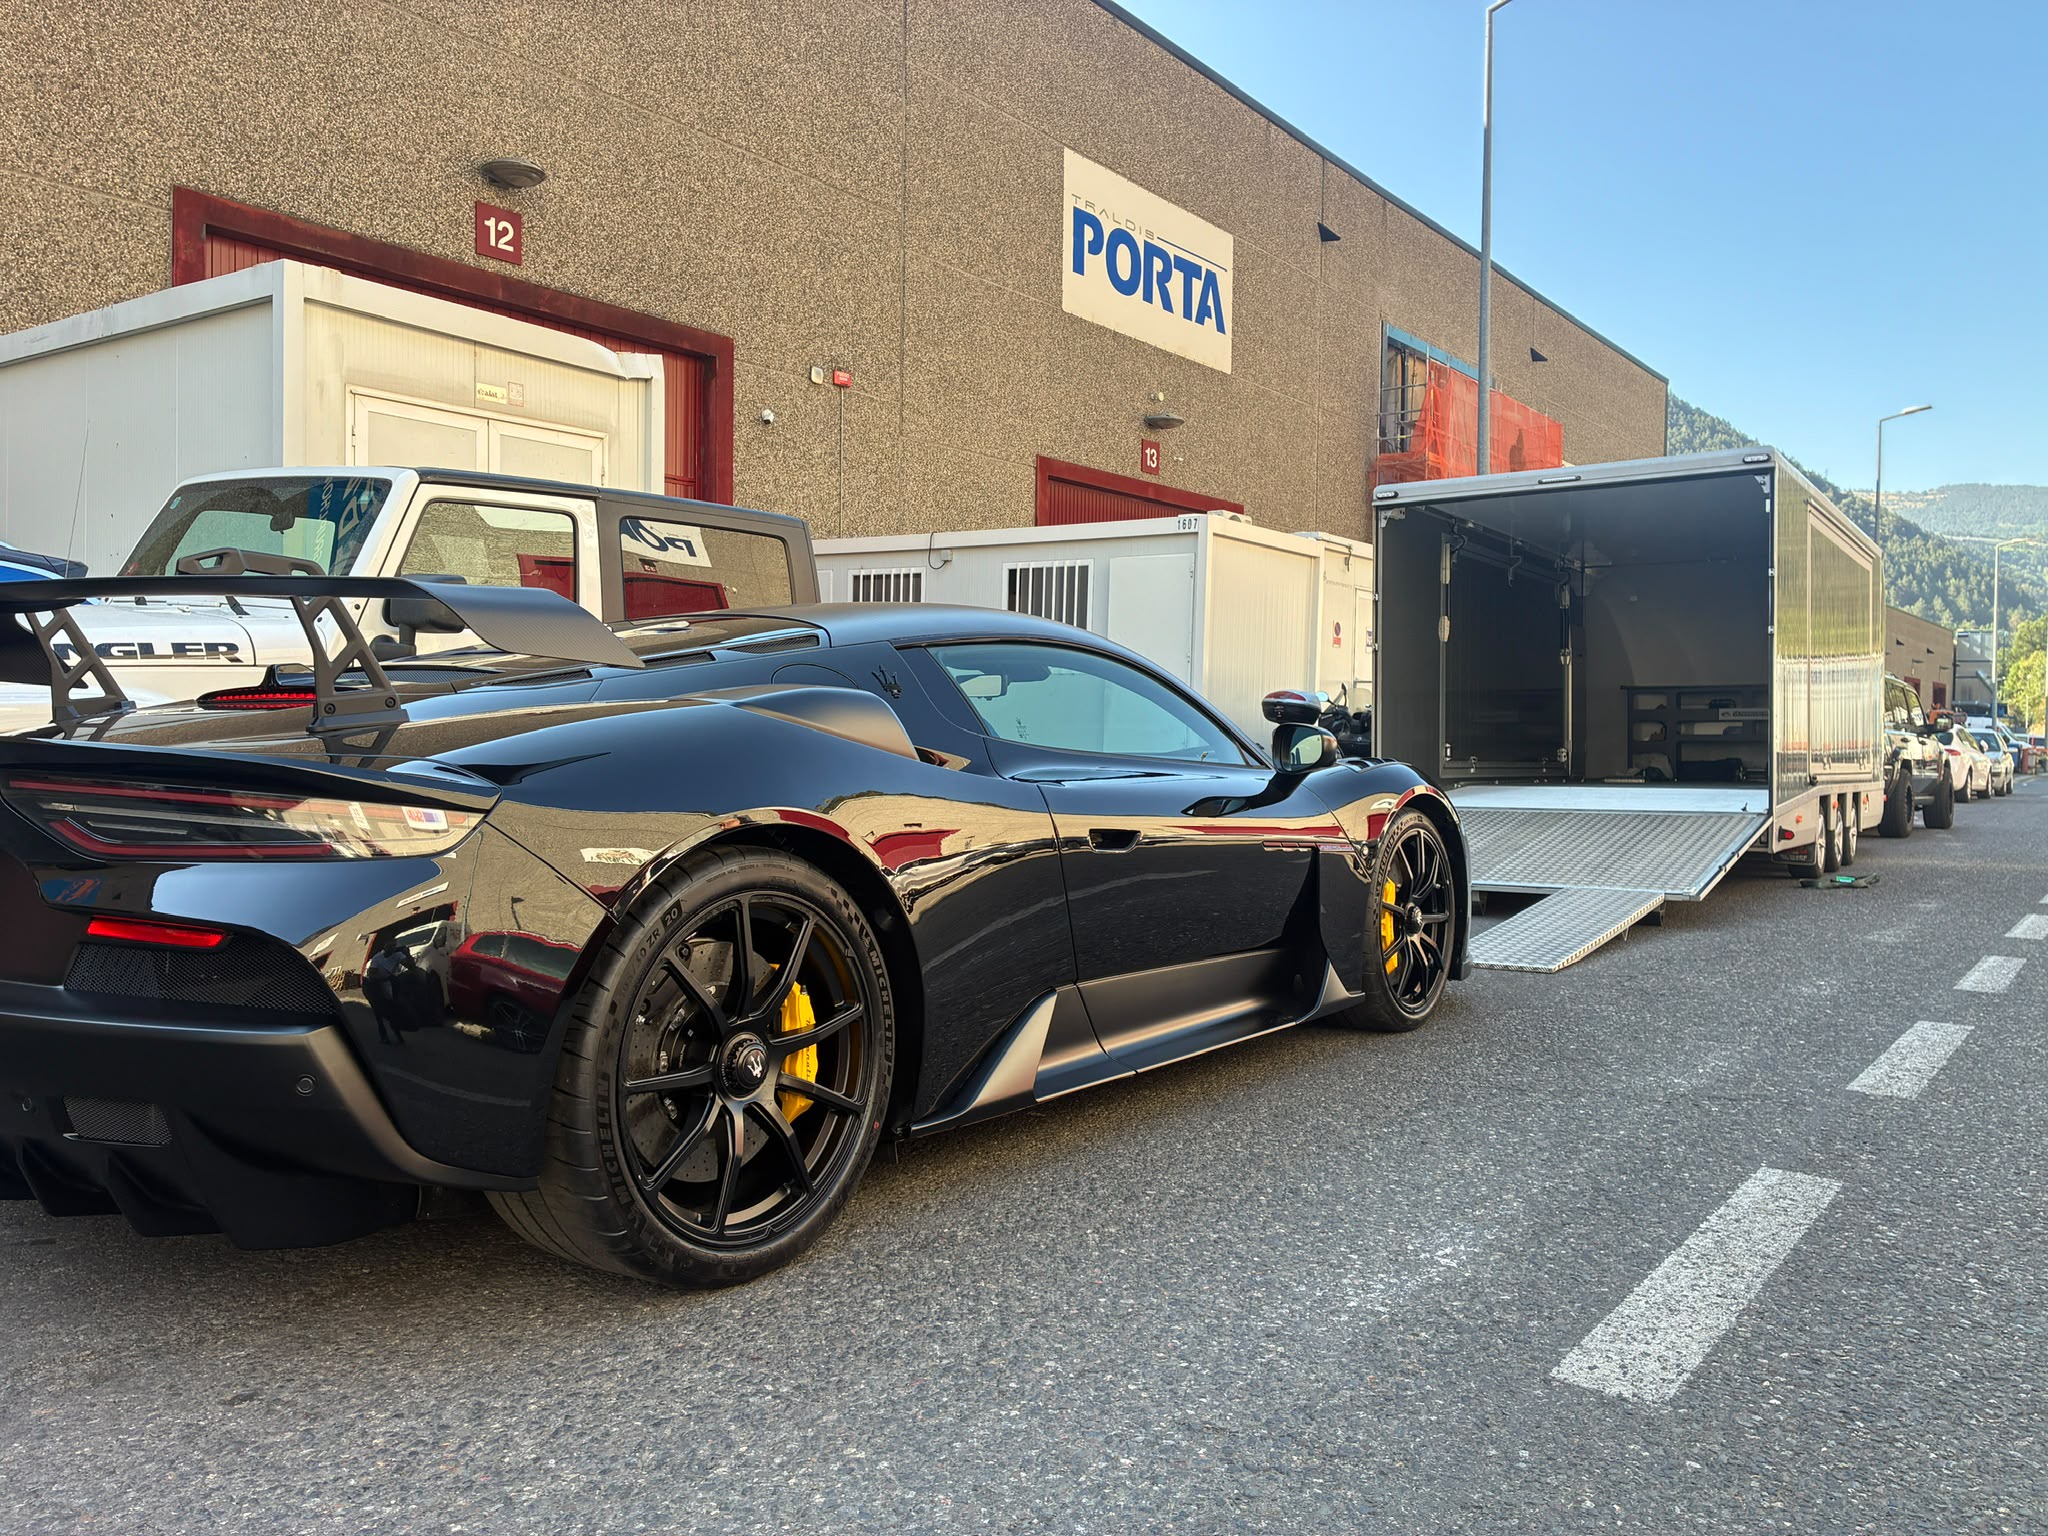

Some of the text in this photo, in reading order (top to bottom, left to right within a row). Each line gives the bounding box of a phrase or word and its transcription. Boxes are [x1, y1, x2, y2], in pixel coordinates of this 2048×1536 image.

[484, 216, 514, 252] 12
[1072, 205, 1227, 336] PORTA
[1145, 447, 1158, 468] 13
[1177, 518, 1199, 531] 1607
[665, 907, 679, 926] 20
[868, 949, 894, 1058] MICHELIN
